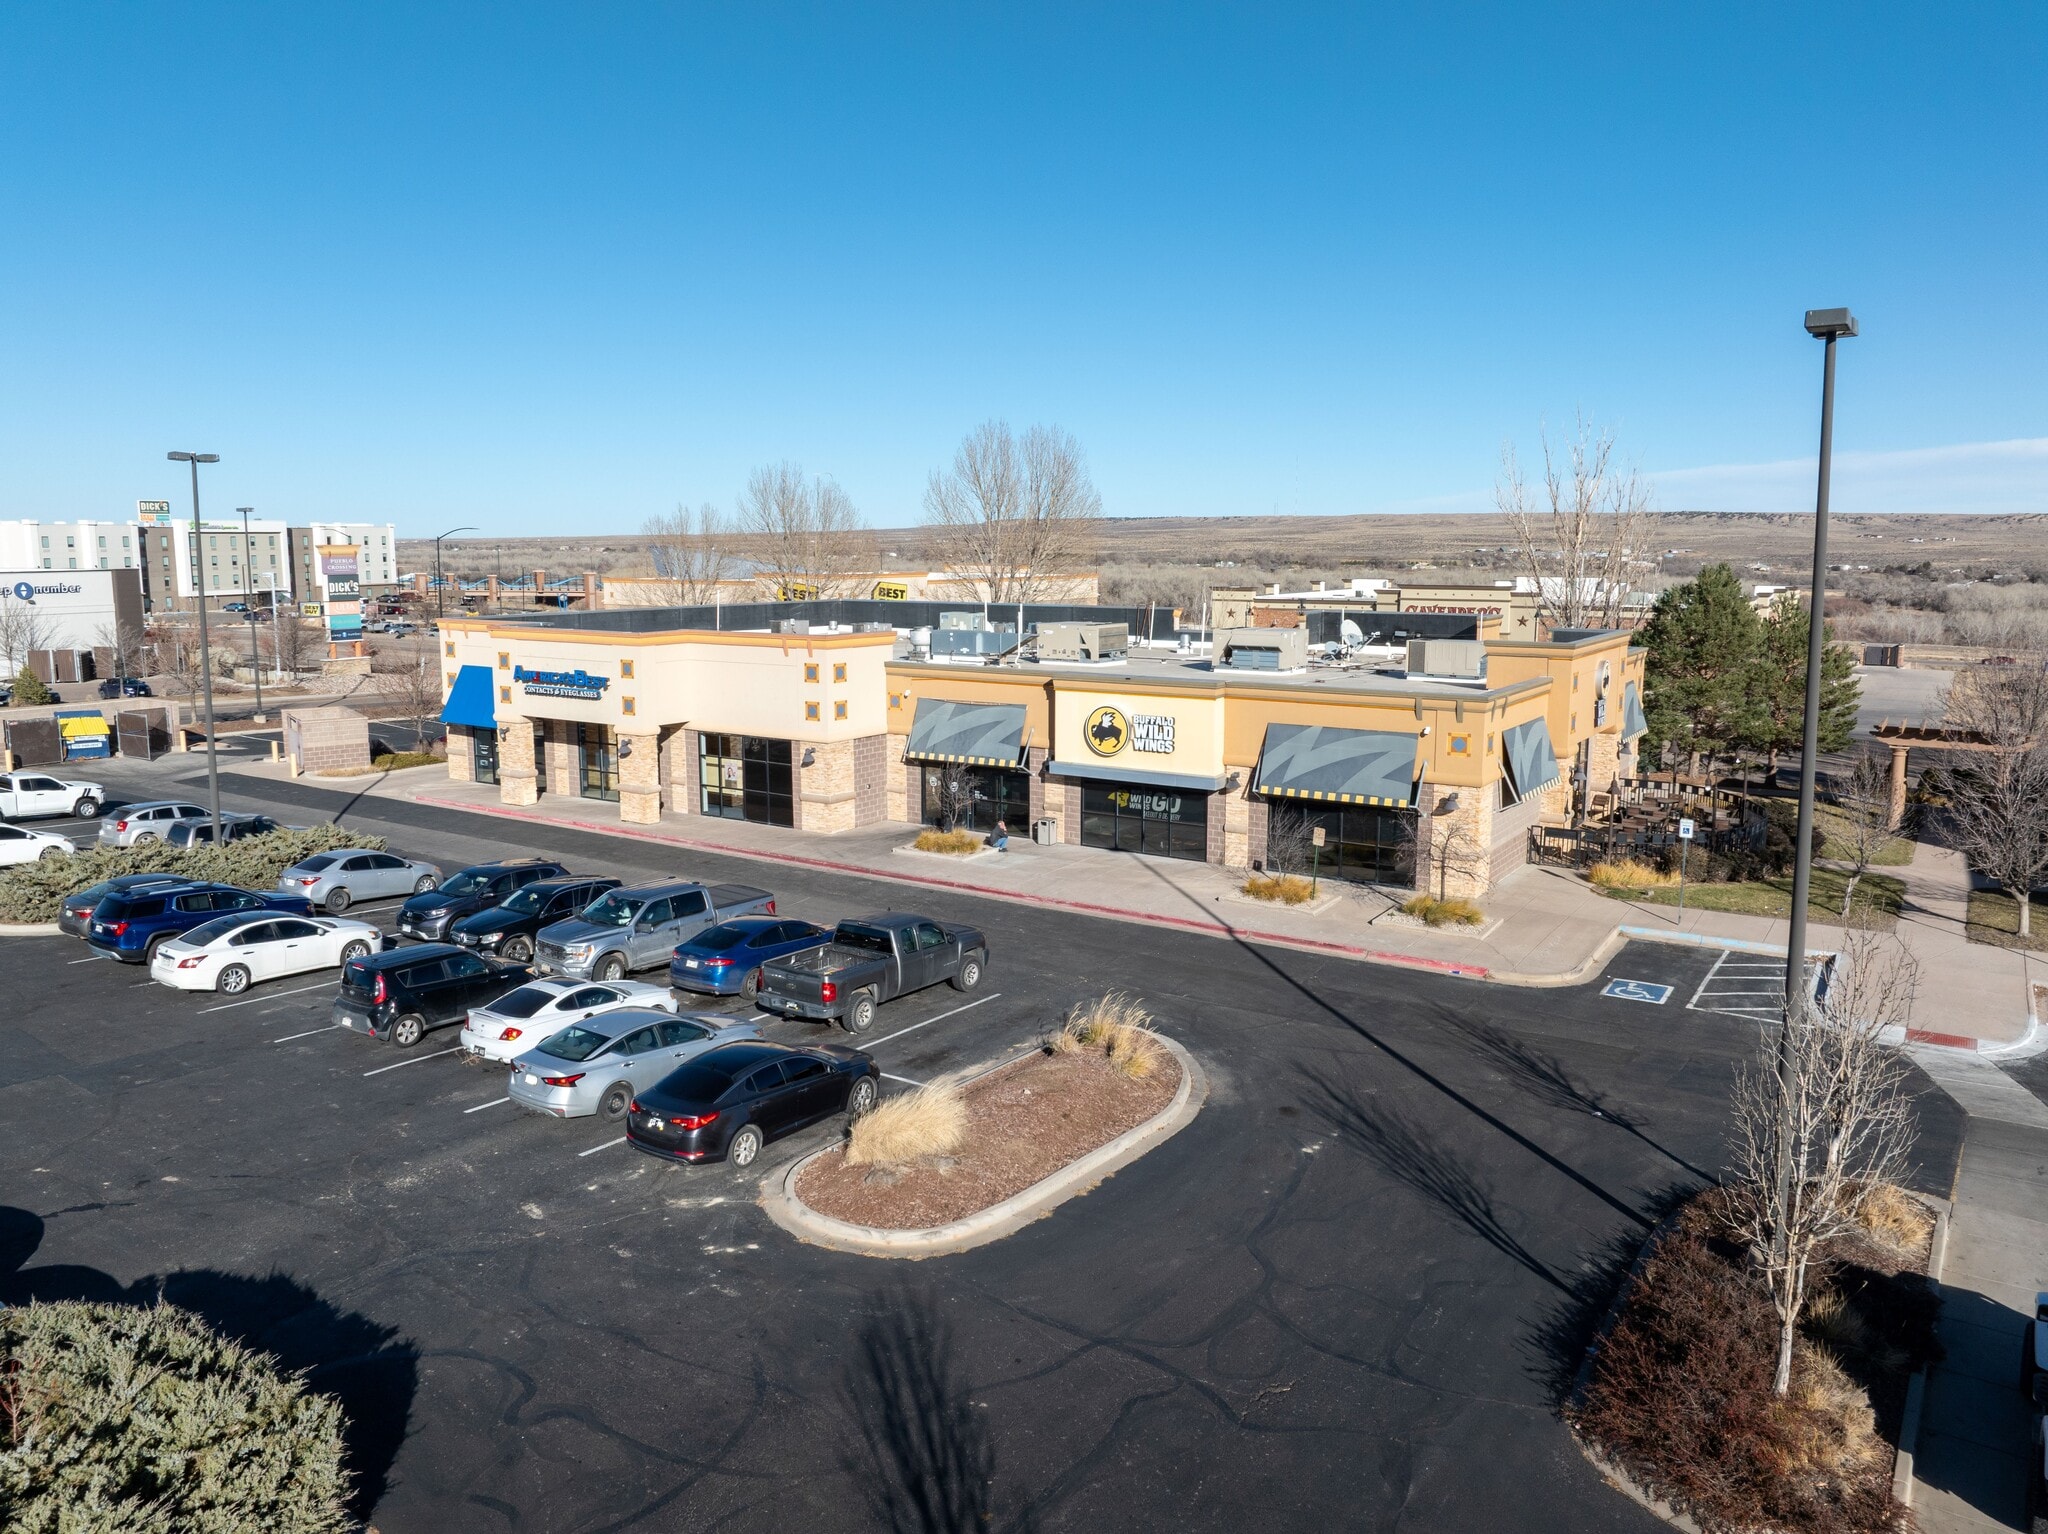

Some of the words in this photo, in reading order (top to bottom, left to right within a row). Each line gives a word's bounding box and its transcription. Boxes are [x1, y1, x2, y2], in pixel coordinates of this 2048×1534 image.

[140, 502, 168, 511] DICK'S
[35, 583, 81, 594] number
[329, 580, 359, 592] DICK'S
[878, 587, 905, 599] BEST
[560, 688, 598, 698] EYEGLASSES
[1133, 714, 1174, 726] BUFFALO
[1133, 724, 1174, 741] WILD
[1133, 738, 1174, 753] WINGS
[1130, 794, 1152, 804] WID
[1129, 802, 1151, 811] WINS
